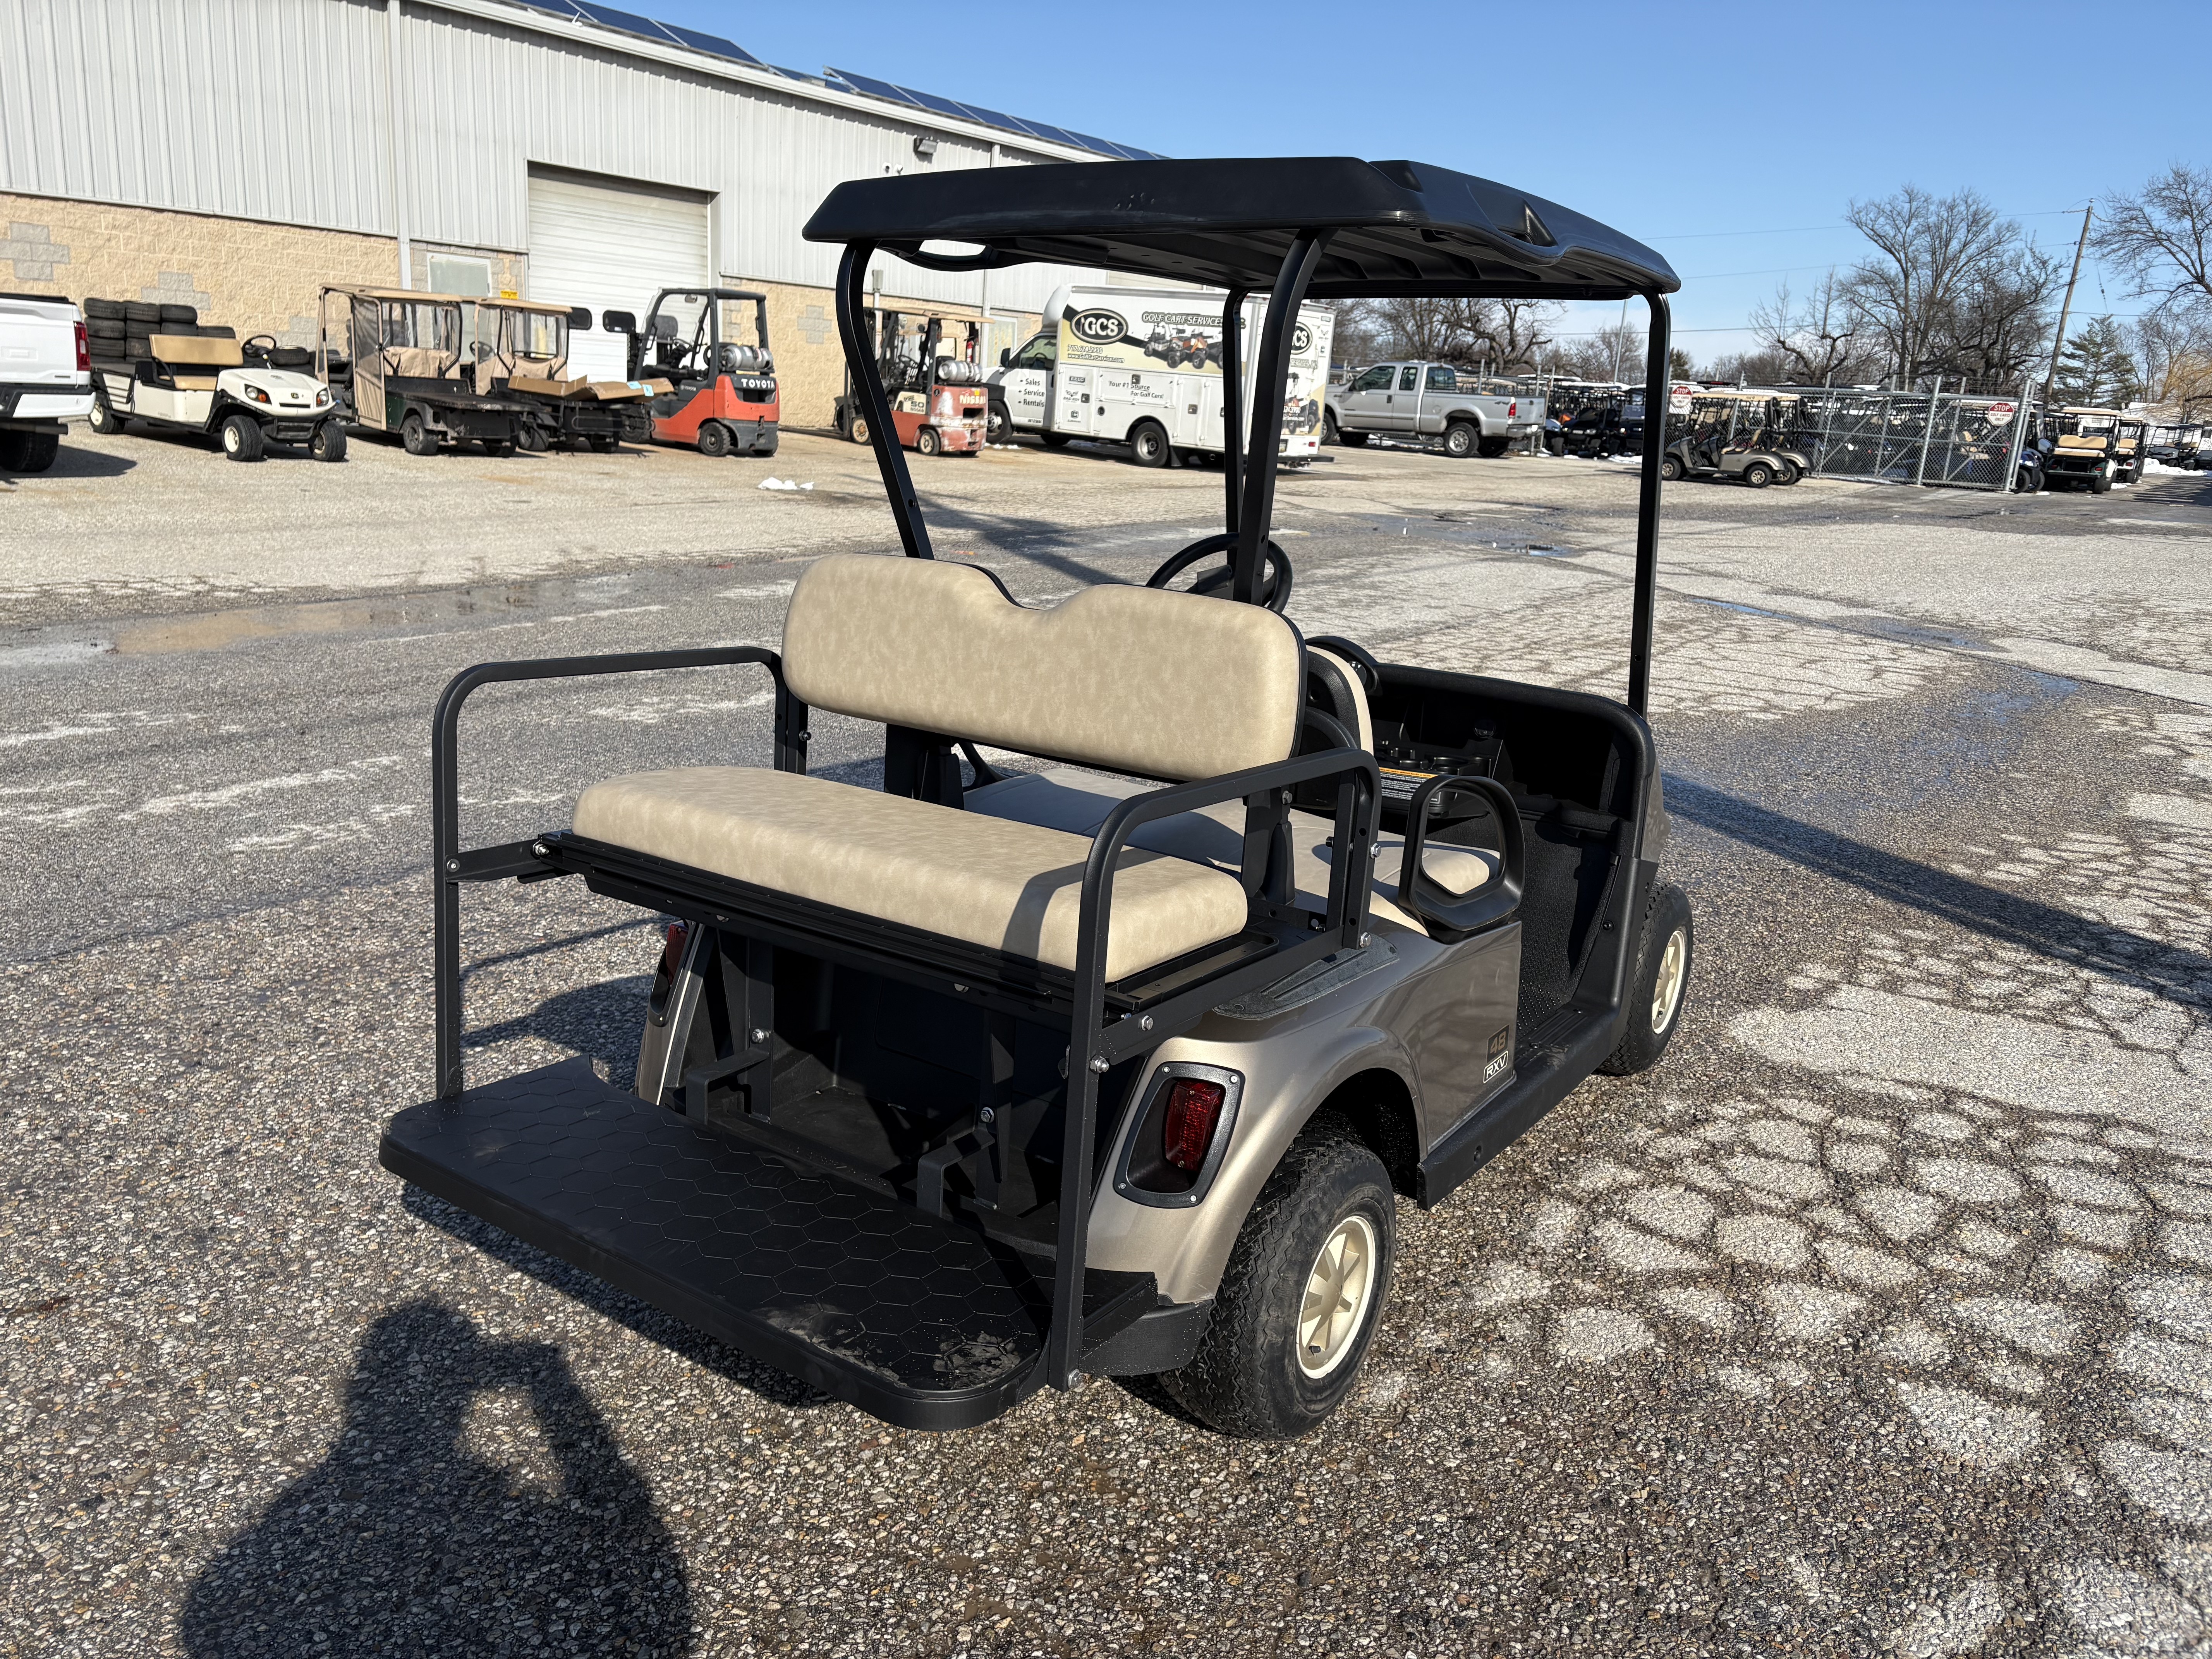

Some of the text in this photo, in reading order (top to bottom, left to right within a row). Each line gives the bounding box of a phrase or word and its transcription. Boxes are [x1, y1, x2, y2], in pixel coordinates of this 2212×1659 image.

[1143, 313, 1164, 322] GOLF
[1165, 314, 1187, 324] CART
[1085, 317, 1119, 336] GCS
[1292, 330, 1308, 347] CS
[741, 378, 775, 389] TOYOTA
[1024, 388, 1045, 397] Service
[1023, 398, 1045, 407] Rentals
[1490, 1031, 1506, 1054] 48
[1486, 1054, 1506, 1079] RXV
